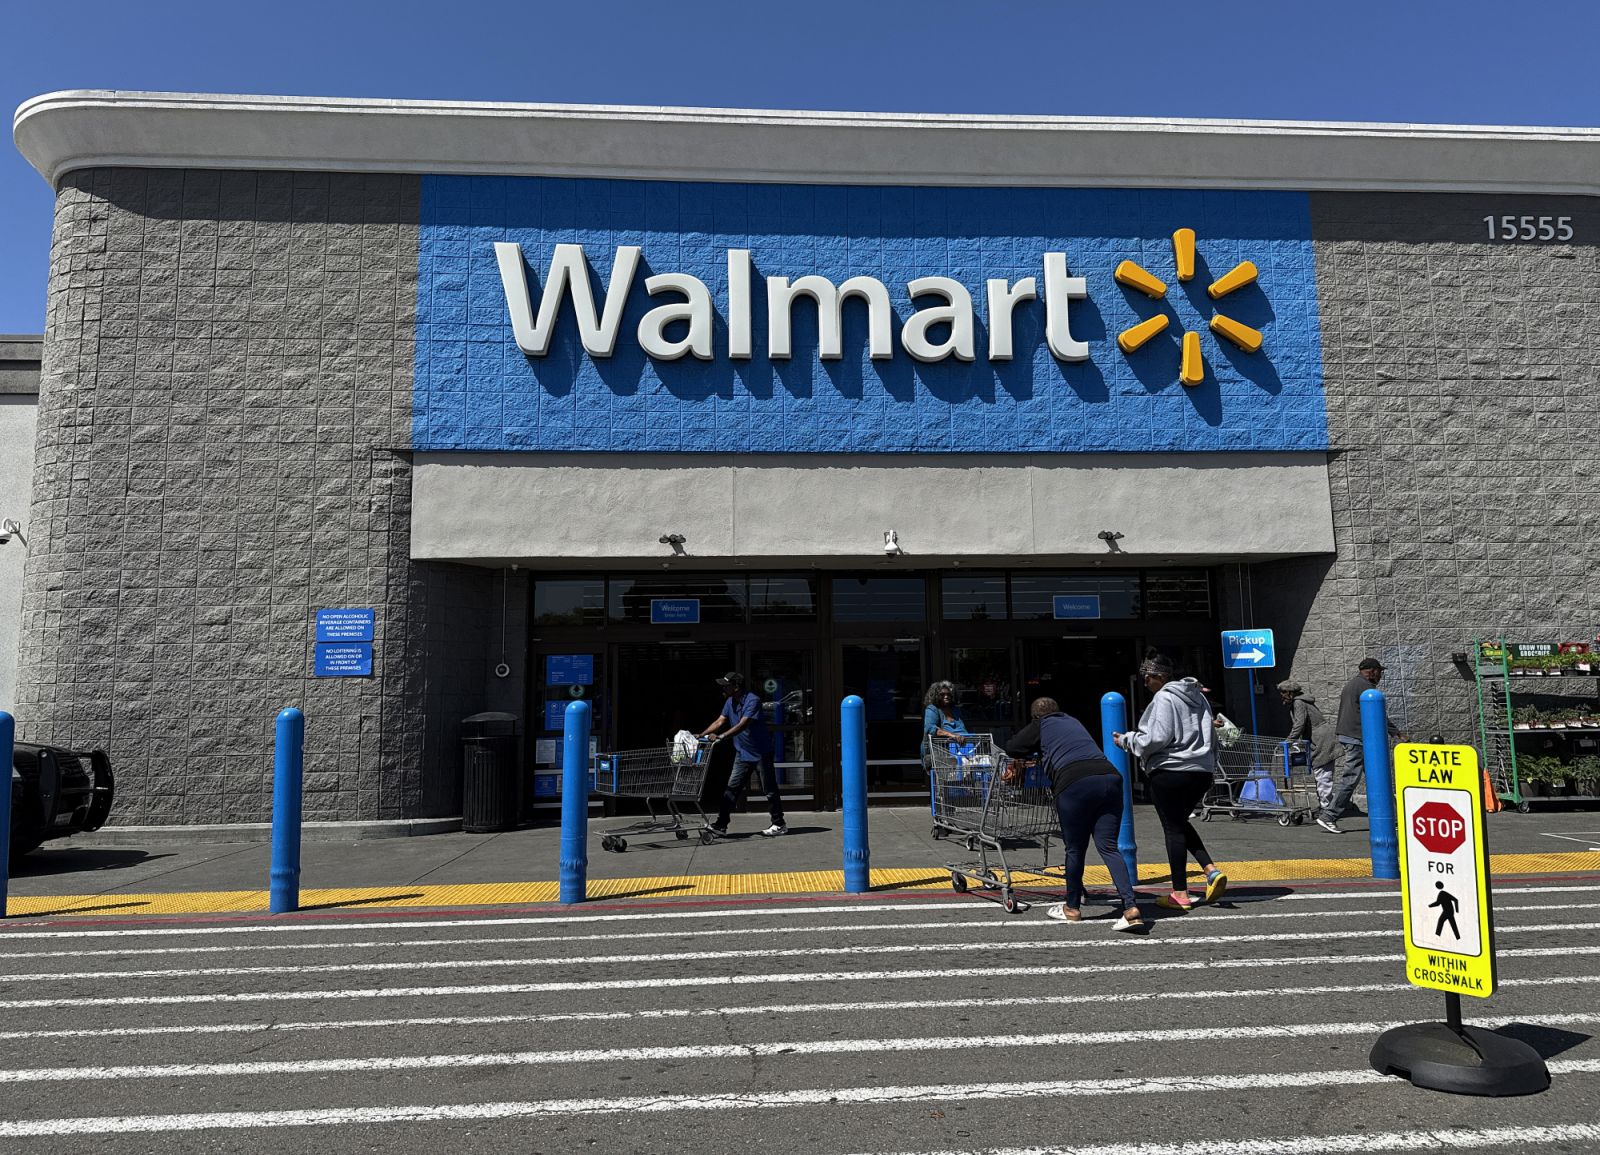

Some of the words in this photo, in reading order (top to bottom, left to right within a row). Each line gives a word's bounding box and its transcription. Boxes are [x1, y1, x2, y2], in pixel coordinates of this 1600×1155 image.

[1483, 215, 1574, 241] 15555
[493, 241, 1090, 362] Walmart
[661, 604, 690, 612] Welcome
[1062, 603, 1091, 611] Welcome
[1228, 635, 1266, 647] Pickup
[1409, 750, 1461, 766] STATE
[1418, 768, 1453, 784] LAW
[1415, 816, 1463, 839] STOP
[1428, 861, 1454, 875] FOR
[1428, 954, 1467, 972] WITHIN
[1414, 967, 1483, 991] CROSSWALK
